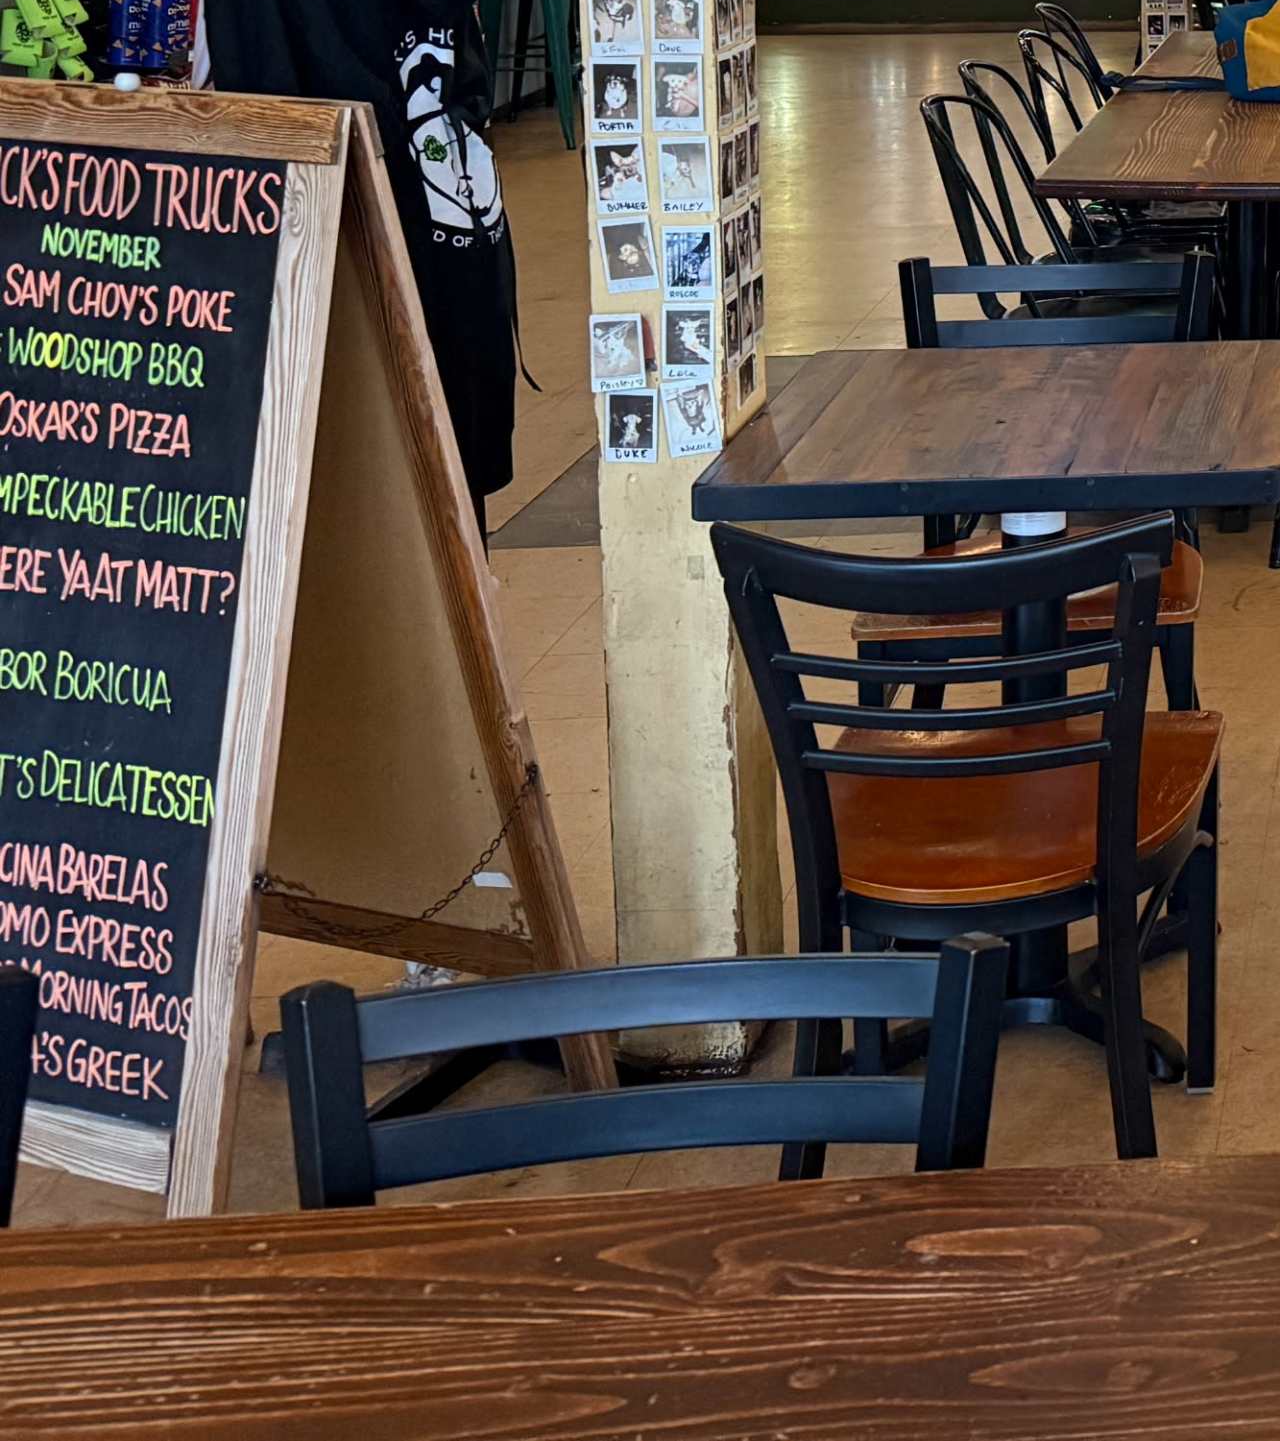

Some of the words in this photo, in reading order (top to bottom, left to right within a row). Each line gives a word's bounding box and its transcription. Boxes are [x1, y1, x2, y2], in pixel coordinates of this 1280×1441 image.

[0, 146, 63, 213] CK'S
[65, 152, 141, 220] FOOD
[145, 162, 282, 235] TRUCKS
[664, 202, 704, 212] BAILEY
[41, 222, 162, 272] NOVEMBER
[452, 234, 474, 248] OF
[4, 263, 61, 312] SAM
[68, 275, 159, 326] CHOY'S
[167, 286, 236, 334] POKE
[8, 326, 144, 382] WOODSHOP
[147, 343, 205, 389] BBQ
[0, 390, 100, 444] OSKAR'S
[108, 402, 192, 458] PIZZA
[615, 449, 648, 459] DUKE
[141, 482, 246, 541] CHICKEN
[134, 557, 237, 617] MATT?
[54, 649, 173, 715] BORICUA
[40, 749, 217, 828] DELICATESSEN
[57, 843, 170, 913] BARELAS
[55, 908, 175, 975] EXPRESS
[123, 979, 195, 1038] TACOS
[67, 1041, 170, 1102] GREEK
